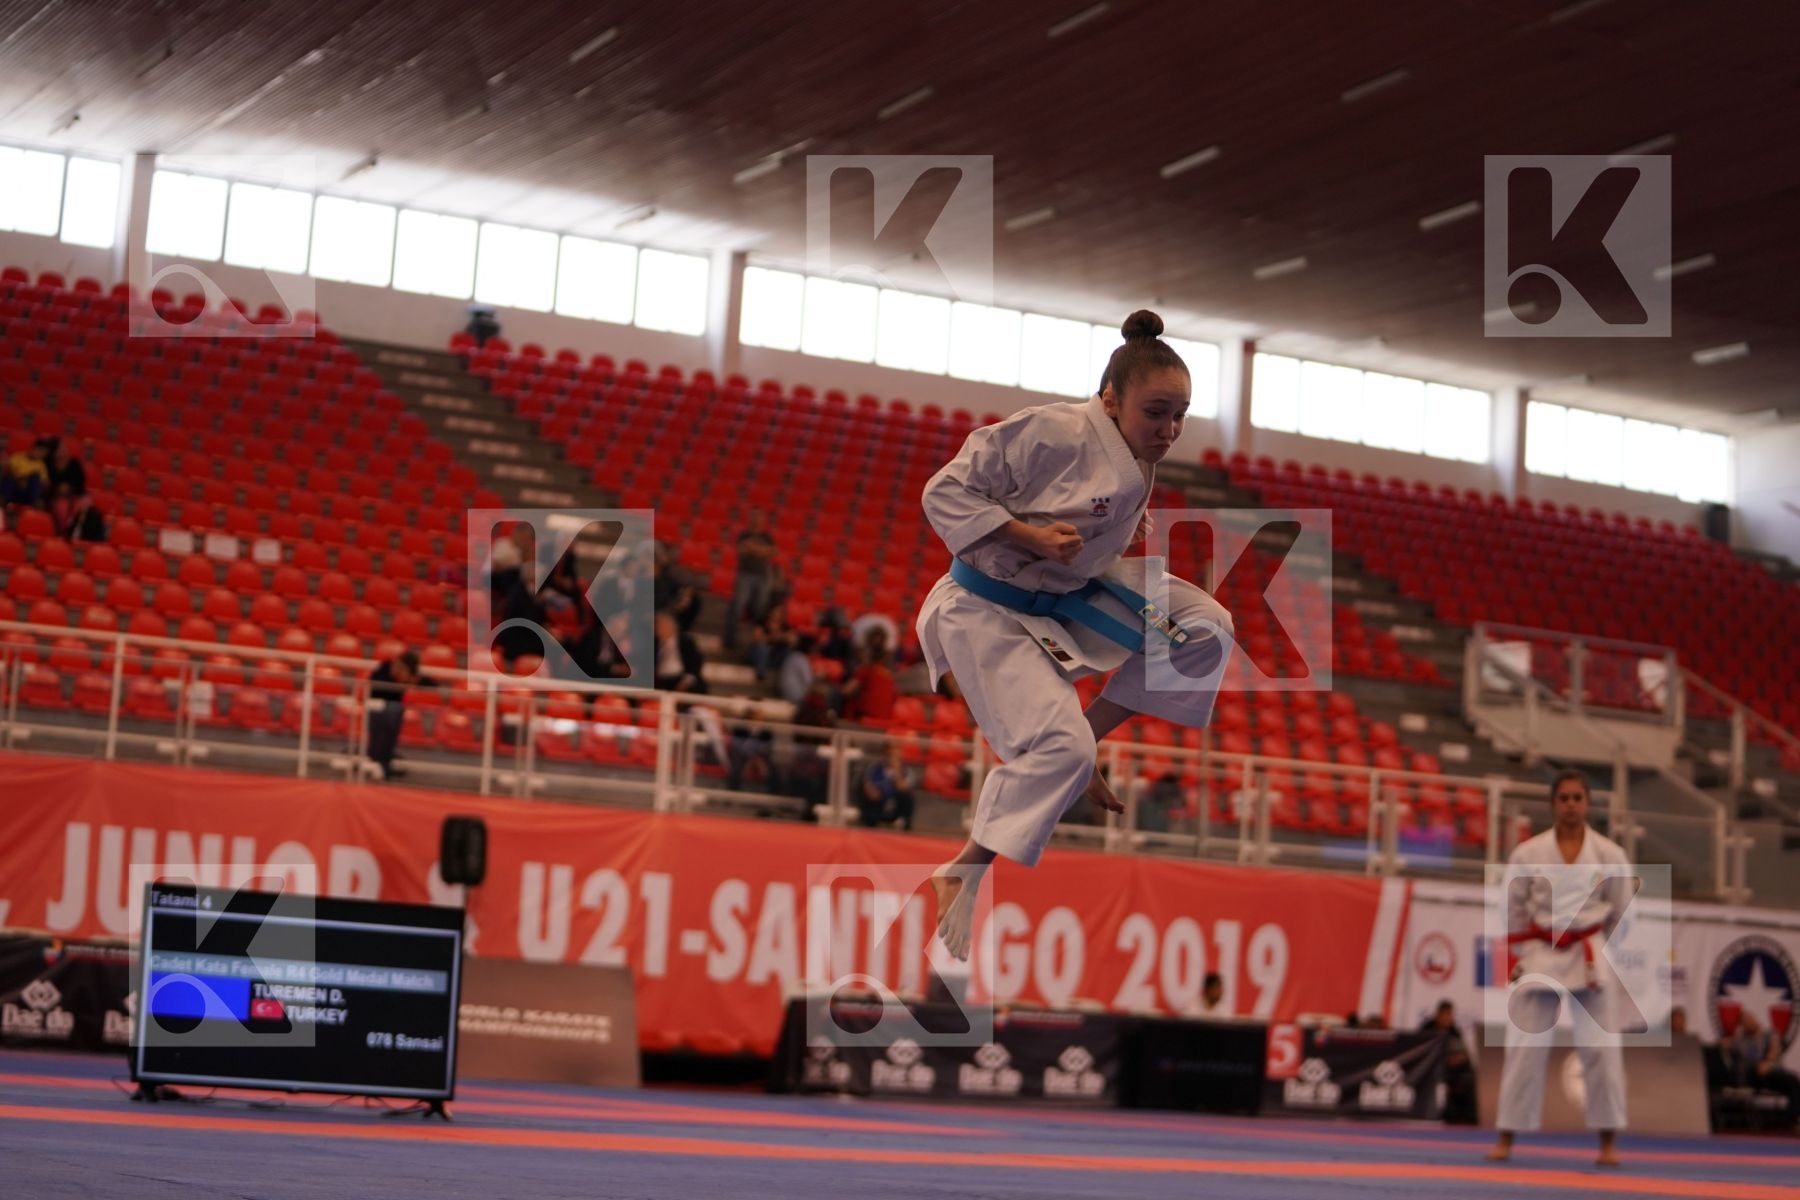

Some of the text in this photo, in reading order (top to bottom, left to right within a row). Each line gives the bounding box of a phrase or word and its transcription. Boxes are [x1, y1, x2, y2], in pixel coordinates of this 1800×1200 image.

[201, 895, 213, 909] 4
[1111, 912, 1289, 1019] 2019
[286, 1005, 348, 1025] TURKEY
[395, 1033, 444, 1050] Sansai
[1270, 1023, 1298, 1071] 5
